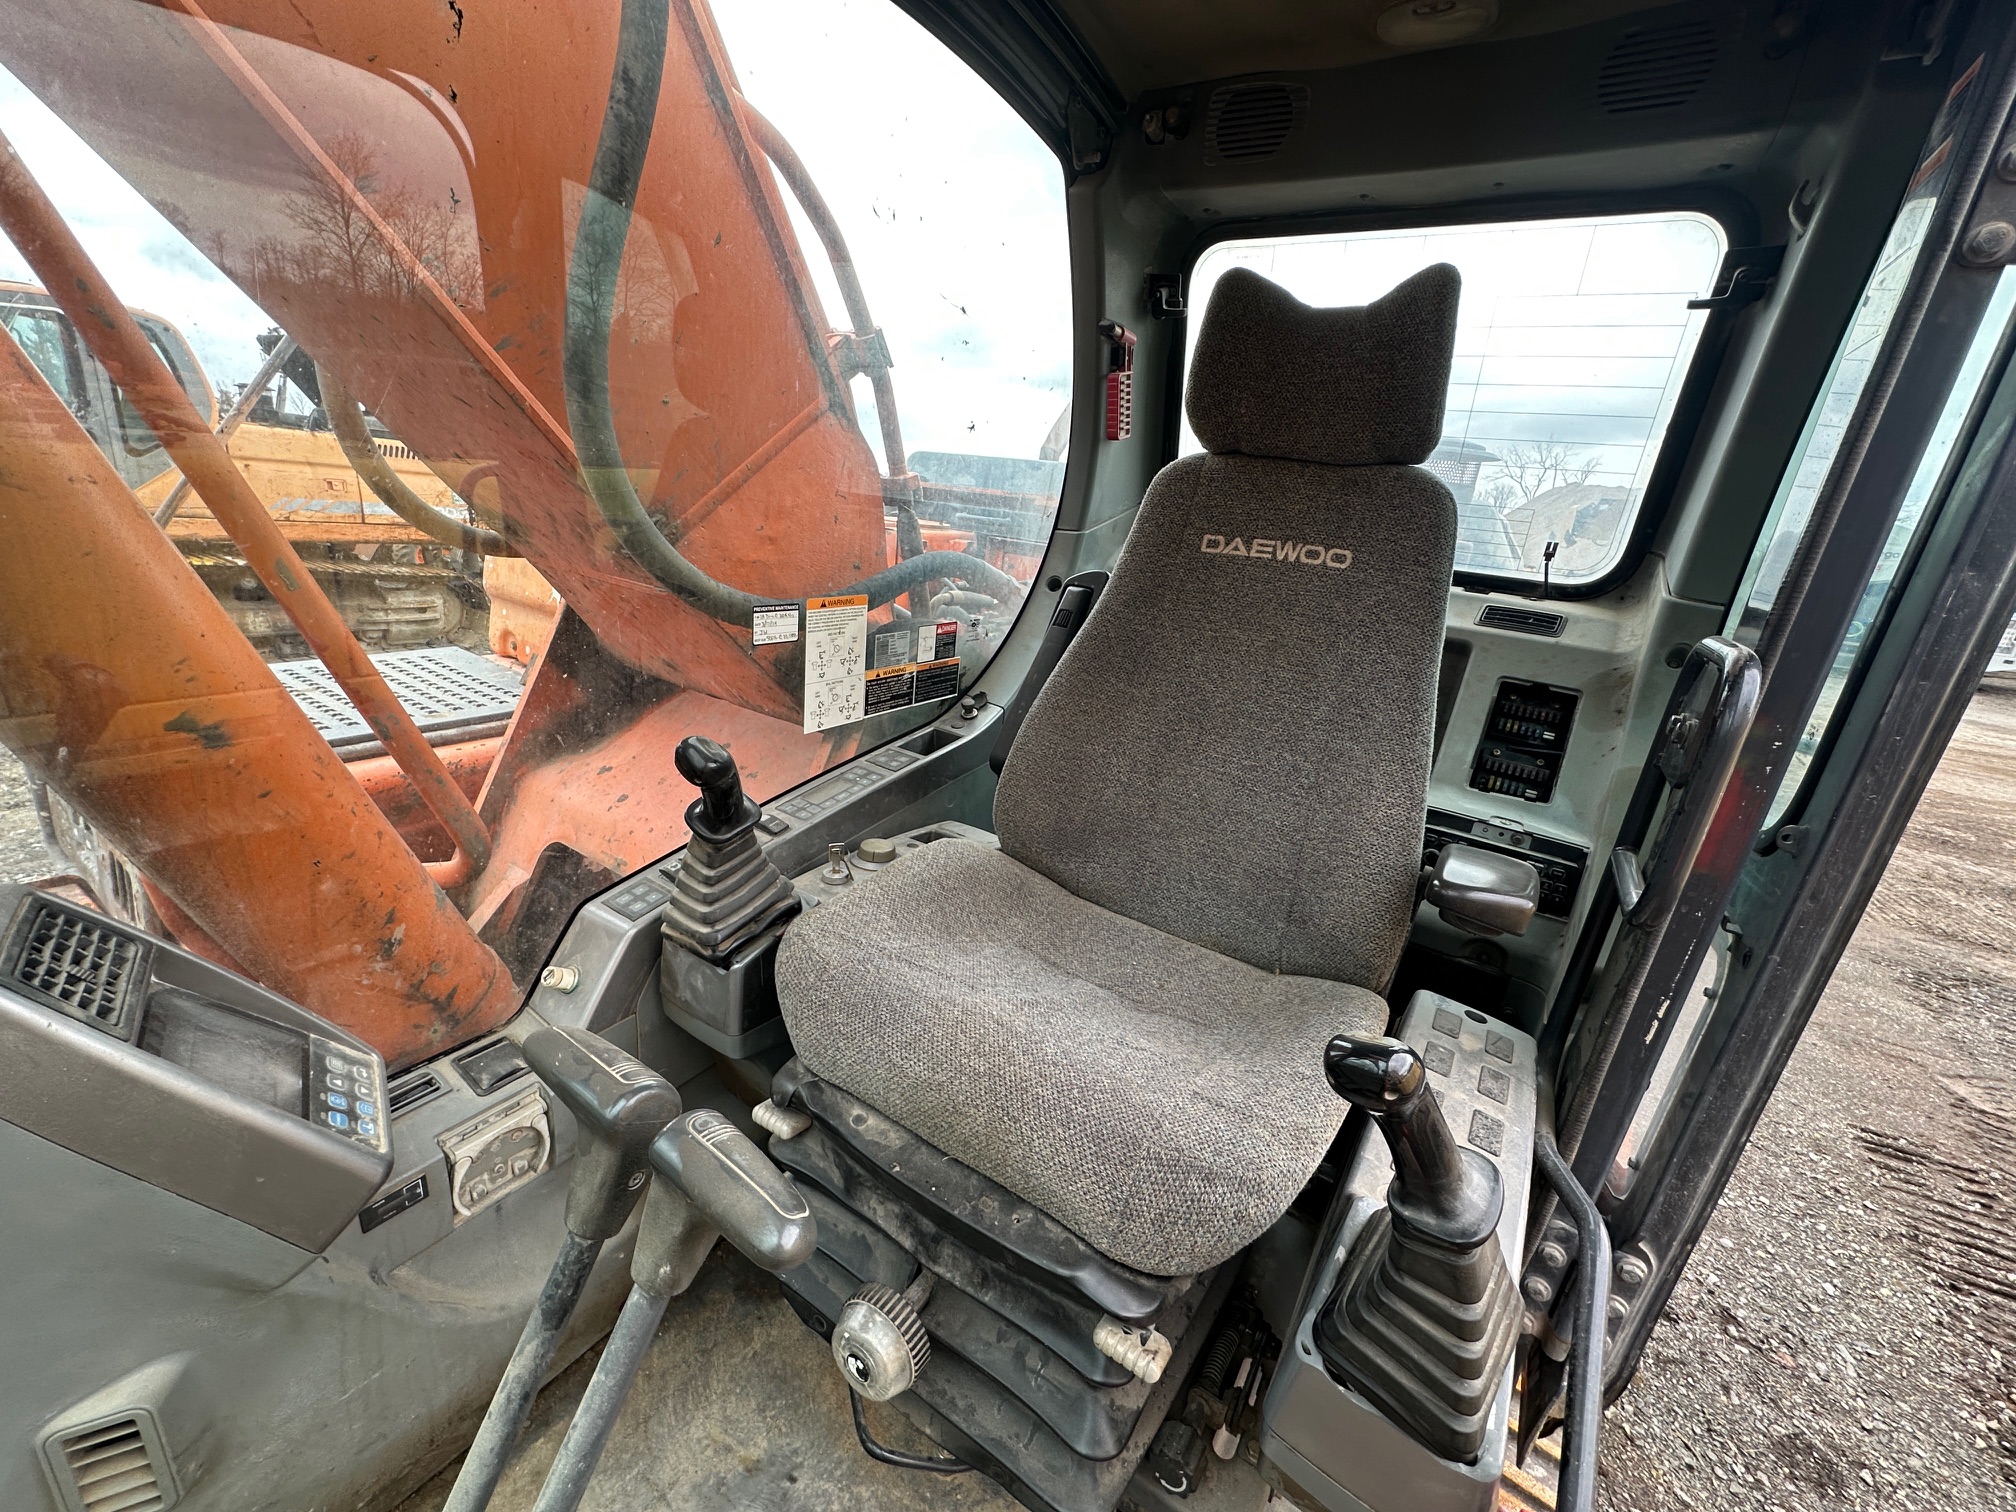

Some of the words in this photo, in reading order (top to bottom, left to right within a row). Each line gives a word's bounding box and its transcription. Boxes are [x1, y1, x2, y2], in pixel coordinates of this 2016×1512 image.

[1200, 534, 1353, 569] DAEWOO
[827, 598, 855, 606] WARNING
[941, 624, 957, 632] DANGER
[882, 666, 907, 676] WARNING
